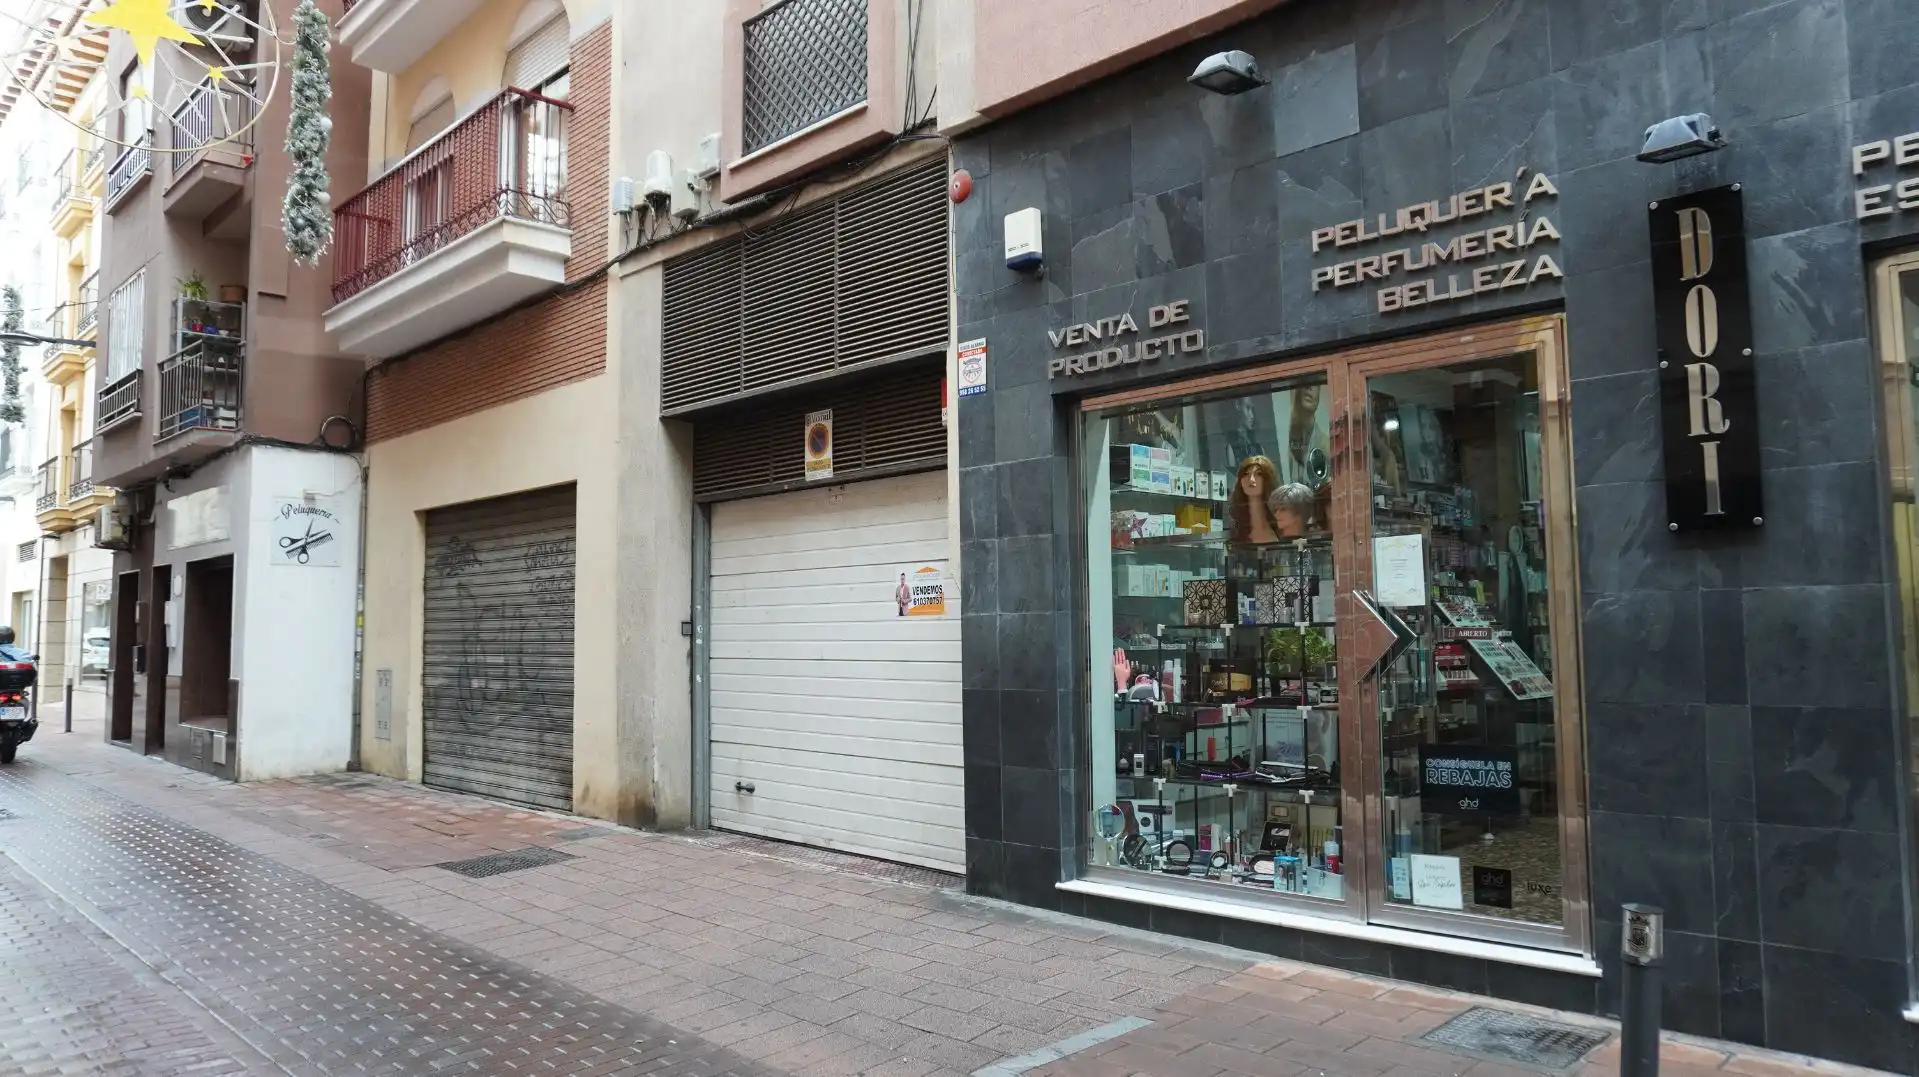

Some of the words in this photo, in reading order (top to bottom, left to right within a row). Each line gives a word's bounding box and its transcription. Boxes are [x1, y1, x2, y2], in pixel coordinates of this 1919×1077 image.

[1378, 254, 1564, 313] BELLEZA
[1047, 312, 1139, 349] VENTA
[1148, 299, 1190, 328] DE
[1048, 328, 1204, 380] PRODUCTO
[1674, 206, 1731, 516] DORI
[912, 584, 943, 596] VENDEMOS
[1425, 767, 1513, 789] REBAJAS
[1457, 796, 1480, 810] ghd
